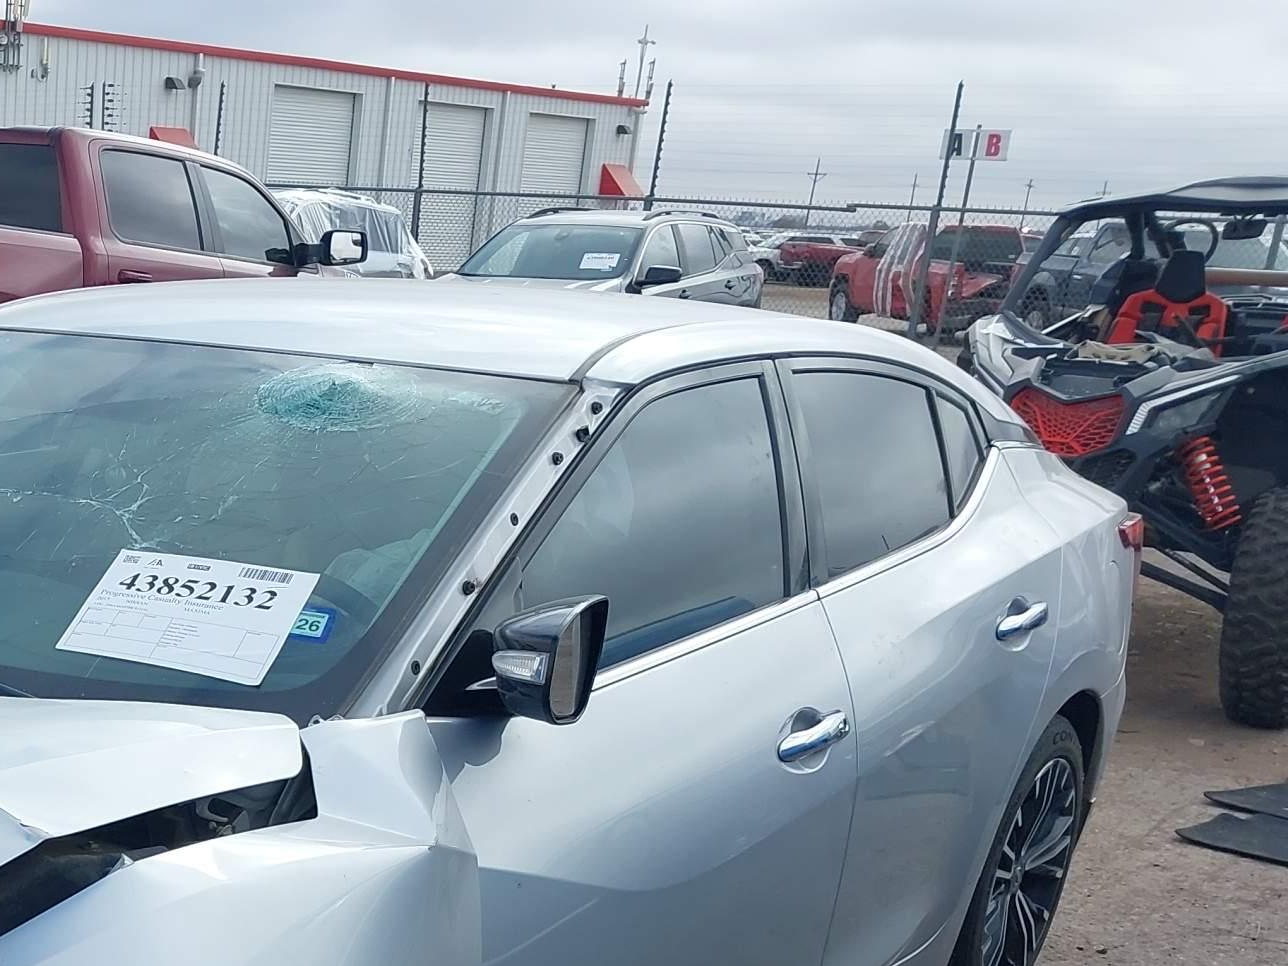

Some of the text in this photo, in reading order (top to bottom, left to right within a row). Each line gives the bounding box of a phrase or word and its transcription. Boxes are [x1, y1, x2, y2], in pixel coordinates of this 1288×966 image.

[949, 133, 963, 156] A
[985, 134, 1001, 156] B
[100, 589, 147, 600] Progressive
[147, 594, 182, 606] Casualty
[184, 599, 224, 611] Insurance
[118, 572, 278, 611] 43852132
[295, 618, 321, 632] 26
